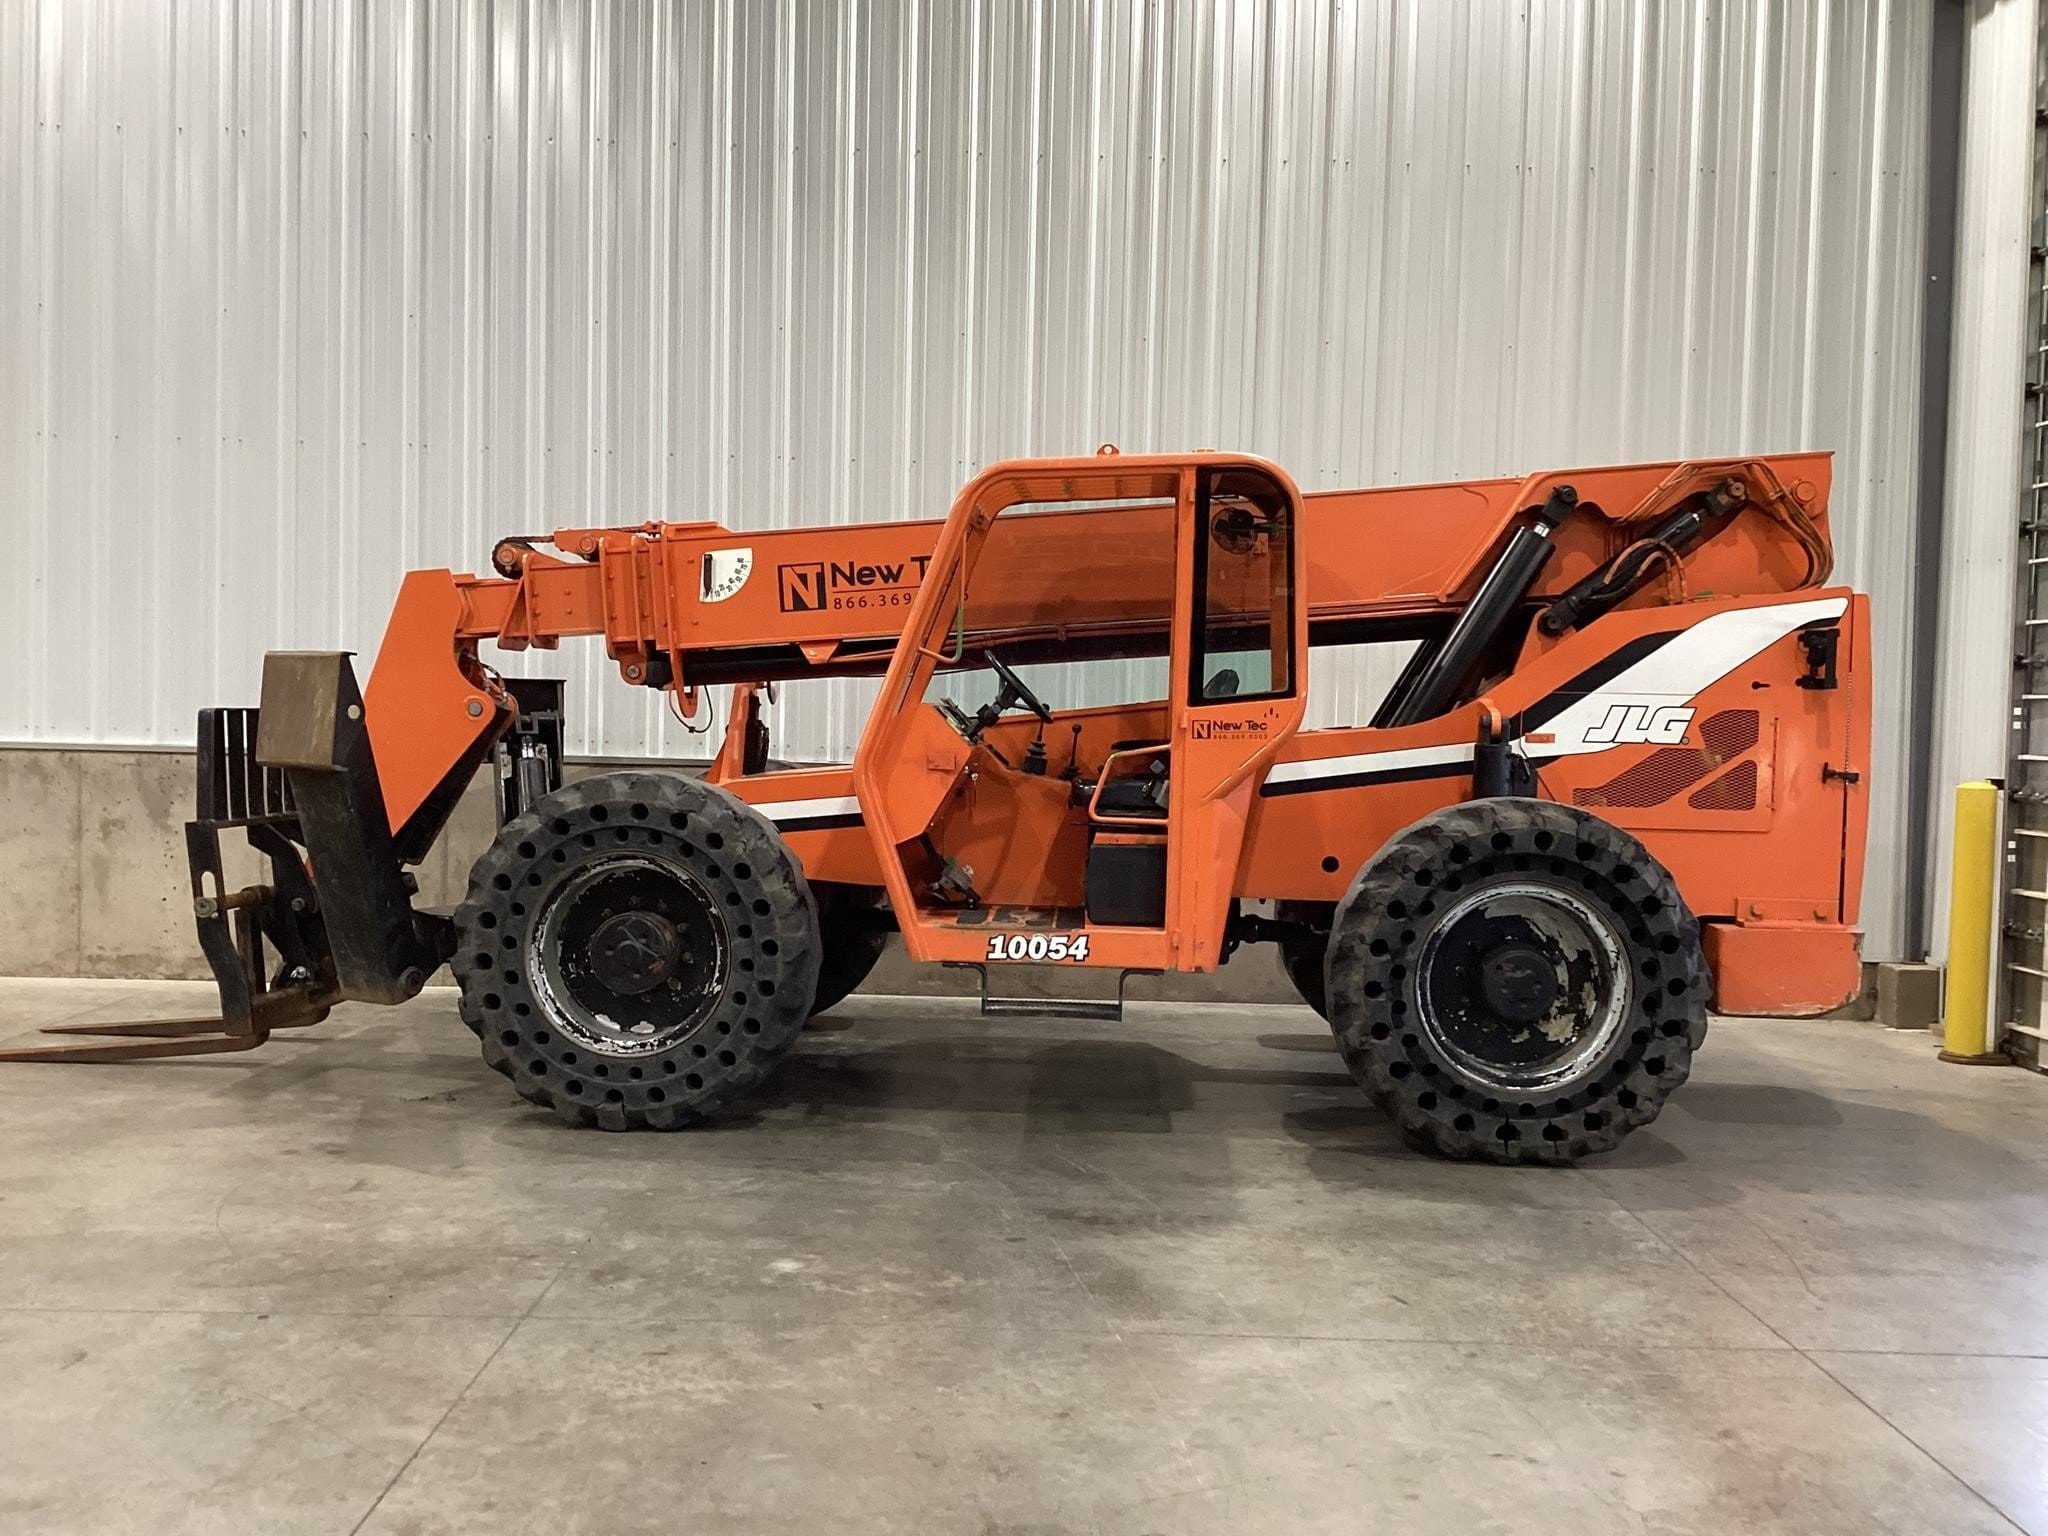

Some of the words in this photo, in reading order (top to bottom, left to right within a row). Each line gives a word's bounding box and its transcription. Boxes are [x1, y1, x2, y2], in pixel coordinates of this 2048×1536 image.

[830, 561, 905, 588] New
[833, 592, 912, 610] 866.369
[1213, 720, 1242, 731] New
[1245, 720, 1268, 731] Tec
[1582, 704, 1697, 745] JLG
[986, 934, 1089, 962] 10054
